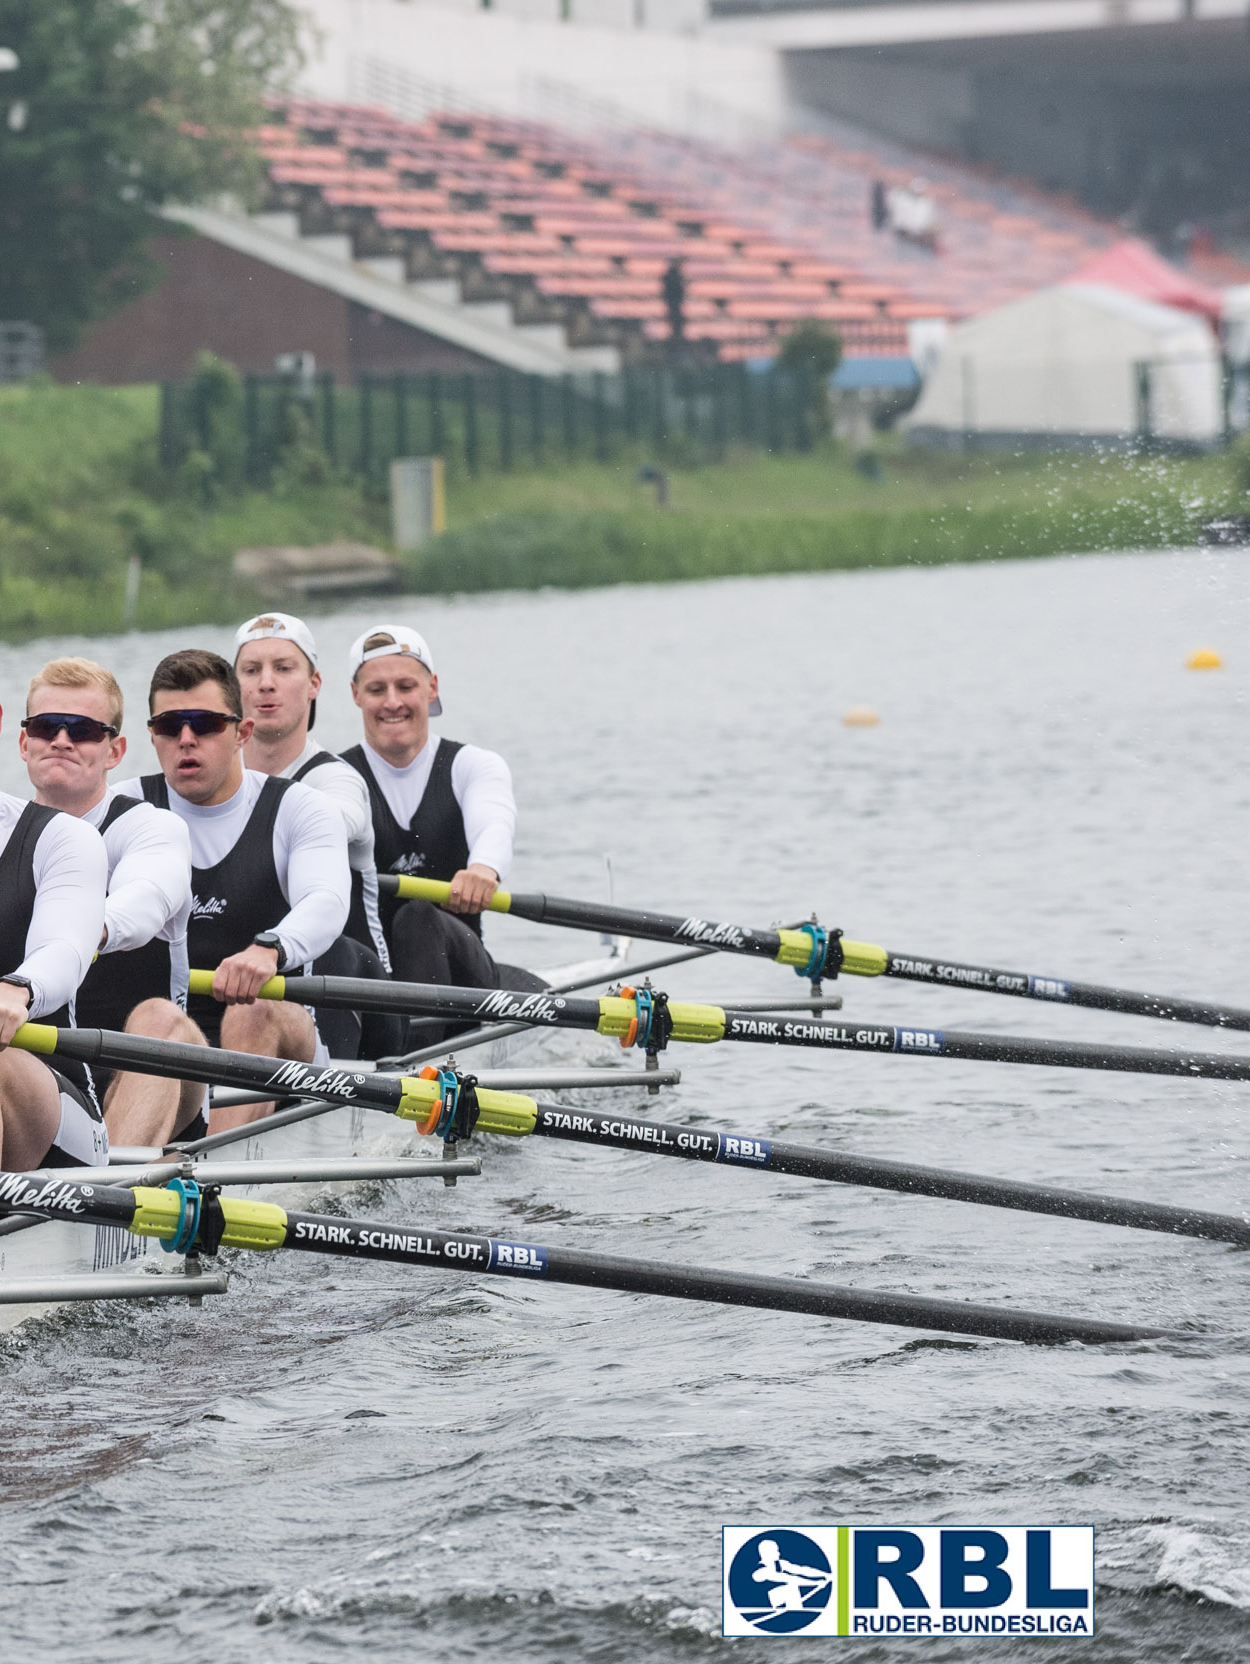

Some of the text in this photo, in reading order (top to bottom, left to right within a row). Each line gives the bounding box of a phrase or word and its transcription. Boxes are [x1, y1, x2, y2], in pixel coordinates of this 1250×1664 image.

[891, 958, 934, 976] STARK.
[1034, 978, 1068, 997] RBL
[730, 1018, 890, 1046] STARK. SCHNELL. GUT.
[900, 1031, 941, 1048] RBL
[542, 1111, 713, 1152] STARK. SCHNELL. GUT.
[725, 1137, 767, 1159] RBL
[294, 1221, 484, 1262] STARK. SCHNELL. GUT.
[496, 1244, 543, 1267] RBL
